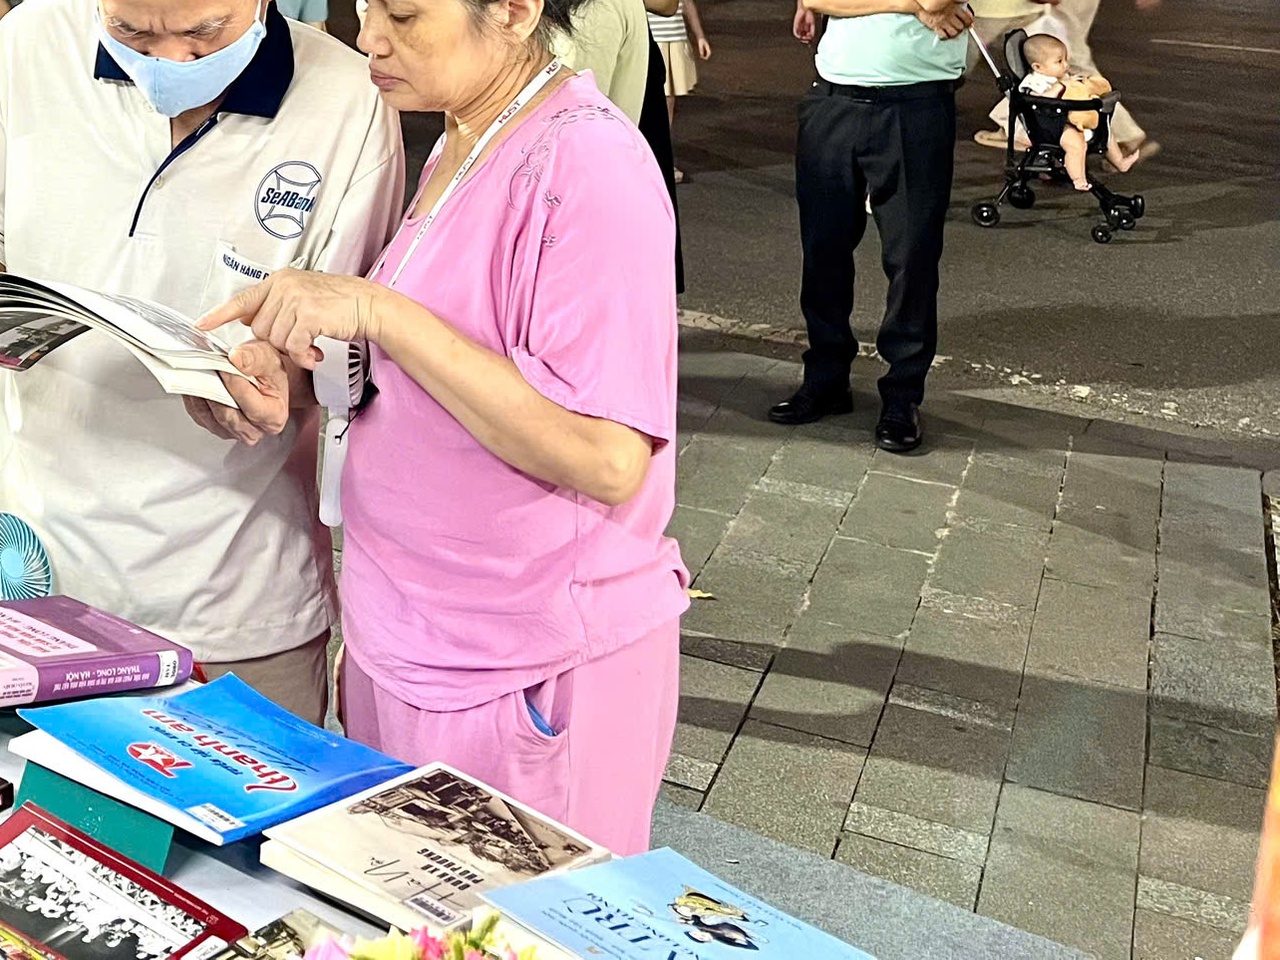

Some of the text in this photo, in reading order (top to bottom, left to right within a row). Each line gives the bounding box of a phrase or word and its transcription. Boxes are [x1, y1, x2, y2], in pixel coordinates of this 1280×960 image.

[261, 187, 315, 212] SeABank
[240, 264, 262, 279] HÀNG
[65, 671, 78, 681] NỘI
[79, 670, 90, 680] HÀ
[96, 667, 115, 677] LONG
[116, 664, 139, 675] THĂNG
[140, 708, 297, 797] thanh âm
[562, 895, 651, 951] TRÙ
